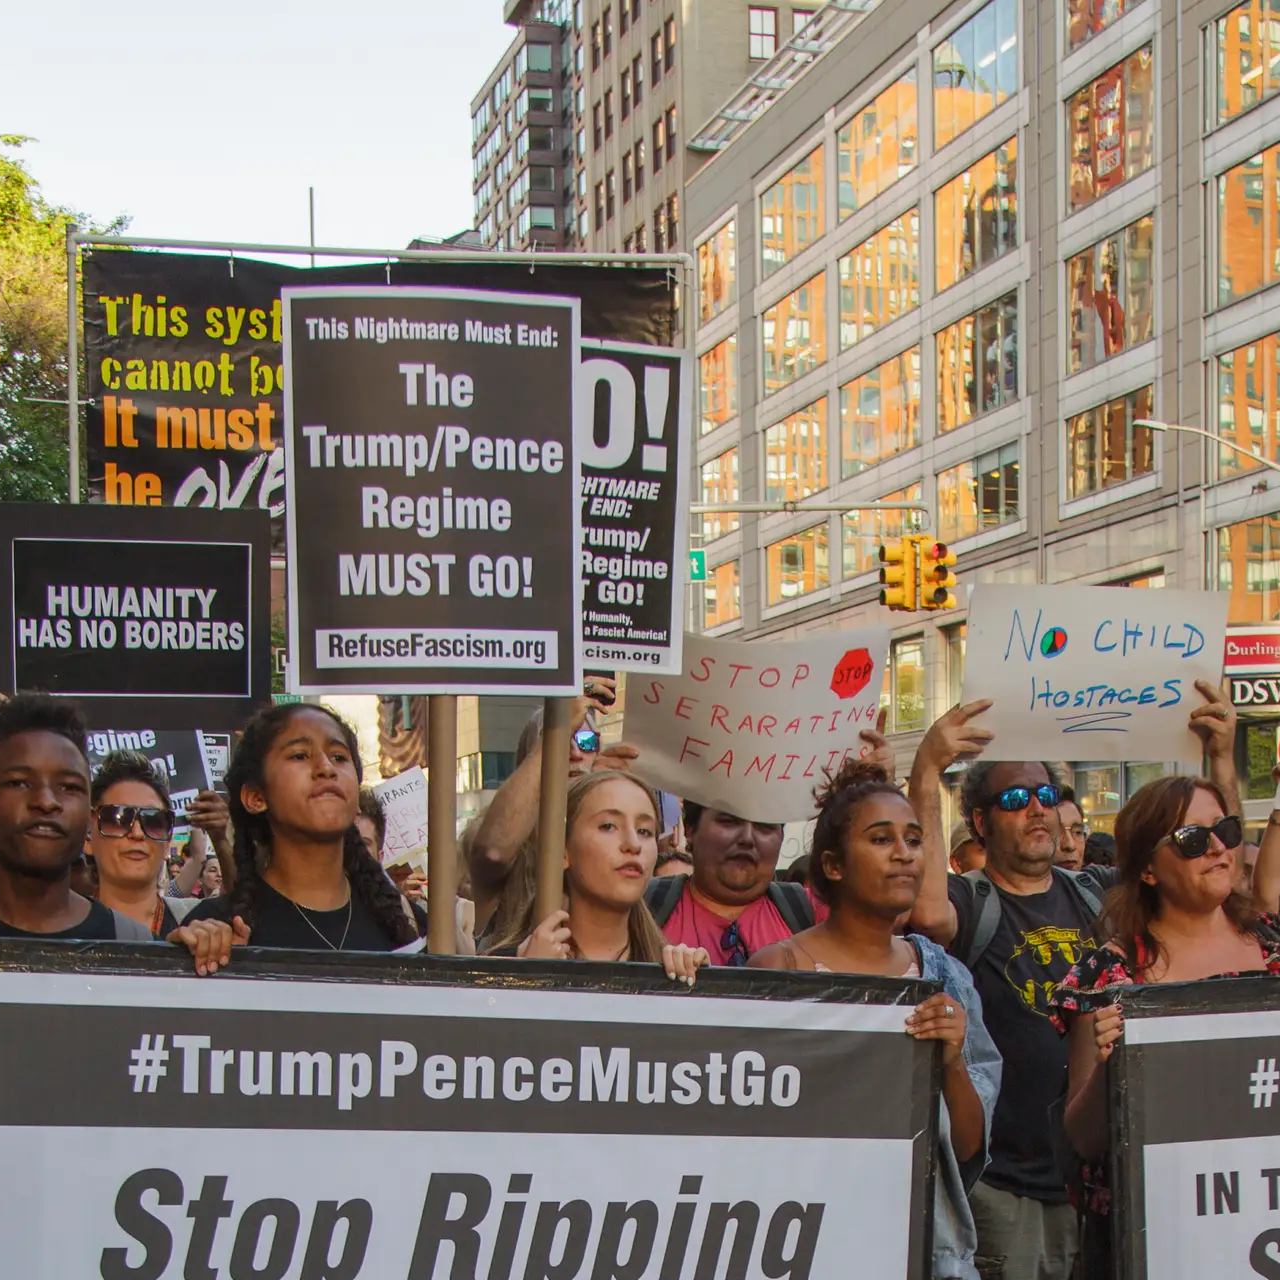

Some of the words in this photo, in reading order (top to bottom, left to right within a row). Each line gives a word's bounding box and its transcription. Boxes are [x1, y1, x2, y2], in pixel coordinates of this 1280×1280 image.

[99, 293, 188, 337] This
[205, 298, 282, 345] syst
[306, 318, 349, 341] This
[354, 317, 459, 343] Nightmare
[465, 320, 511, 345] Must
[517, 324, 559, 348] End:
[101, 353, 235, 396] cannot
[399, 363, 474, 408] The
[104, 395, 139, 448] It
[156, 402, 276, 451] must
[581, 358, 670, 473] O!
[302, 426, 564, 477] Trump/Pence
[362, 486, 512, 538] Regime
[590, 498, 633, 518] END:
[582, 527, 651, 552] rump/
[339, 553, 456, 597] MUST
[469, 555, 533, 598] GO!
[582, 552, 668, 579] Regime
[47, 585, 217, 619] HUMANITY
[598, 581, 644, 606] GO!
[19, 618, 72, 648] HAS
[80, 620, 117, 649] NO
[124, 620, 245, 651] BORDERS
[584, 626, 590, 636] a
[592, 625, 625, 638] Fascist
[627, 628, 667, 641] America!
[589, 611, 633, 626] Humanity,
[328, 633, 546, 664] RefuseFascism.org
[585, 646, 660, 664] cism.org
[1094, 619, 1204, 658] CHILD
[690, 657, 810, 689] STOP
[835, 662, 871, 684] STOP
[1030, 676, 1181, 711] HOSTAGES
[87, 730, 156, 756] egime
[128, 1034, 802, 1111] #TrumpPenceMustGo
[1195, 1171, 1239, 1217] IN
